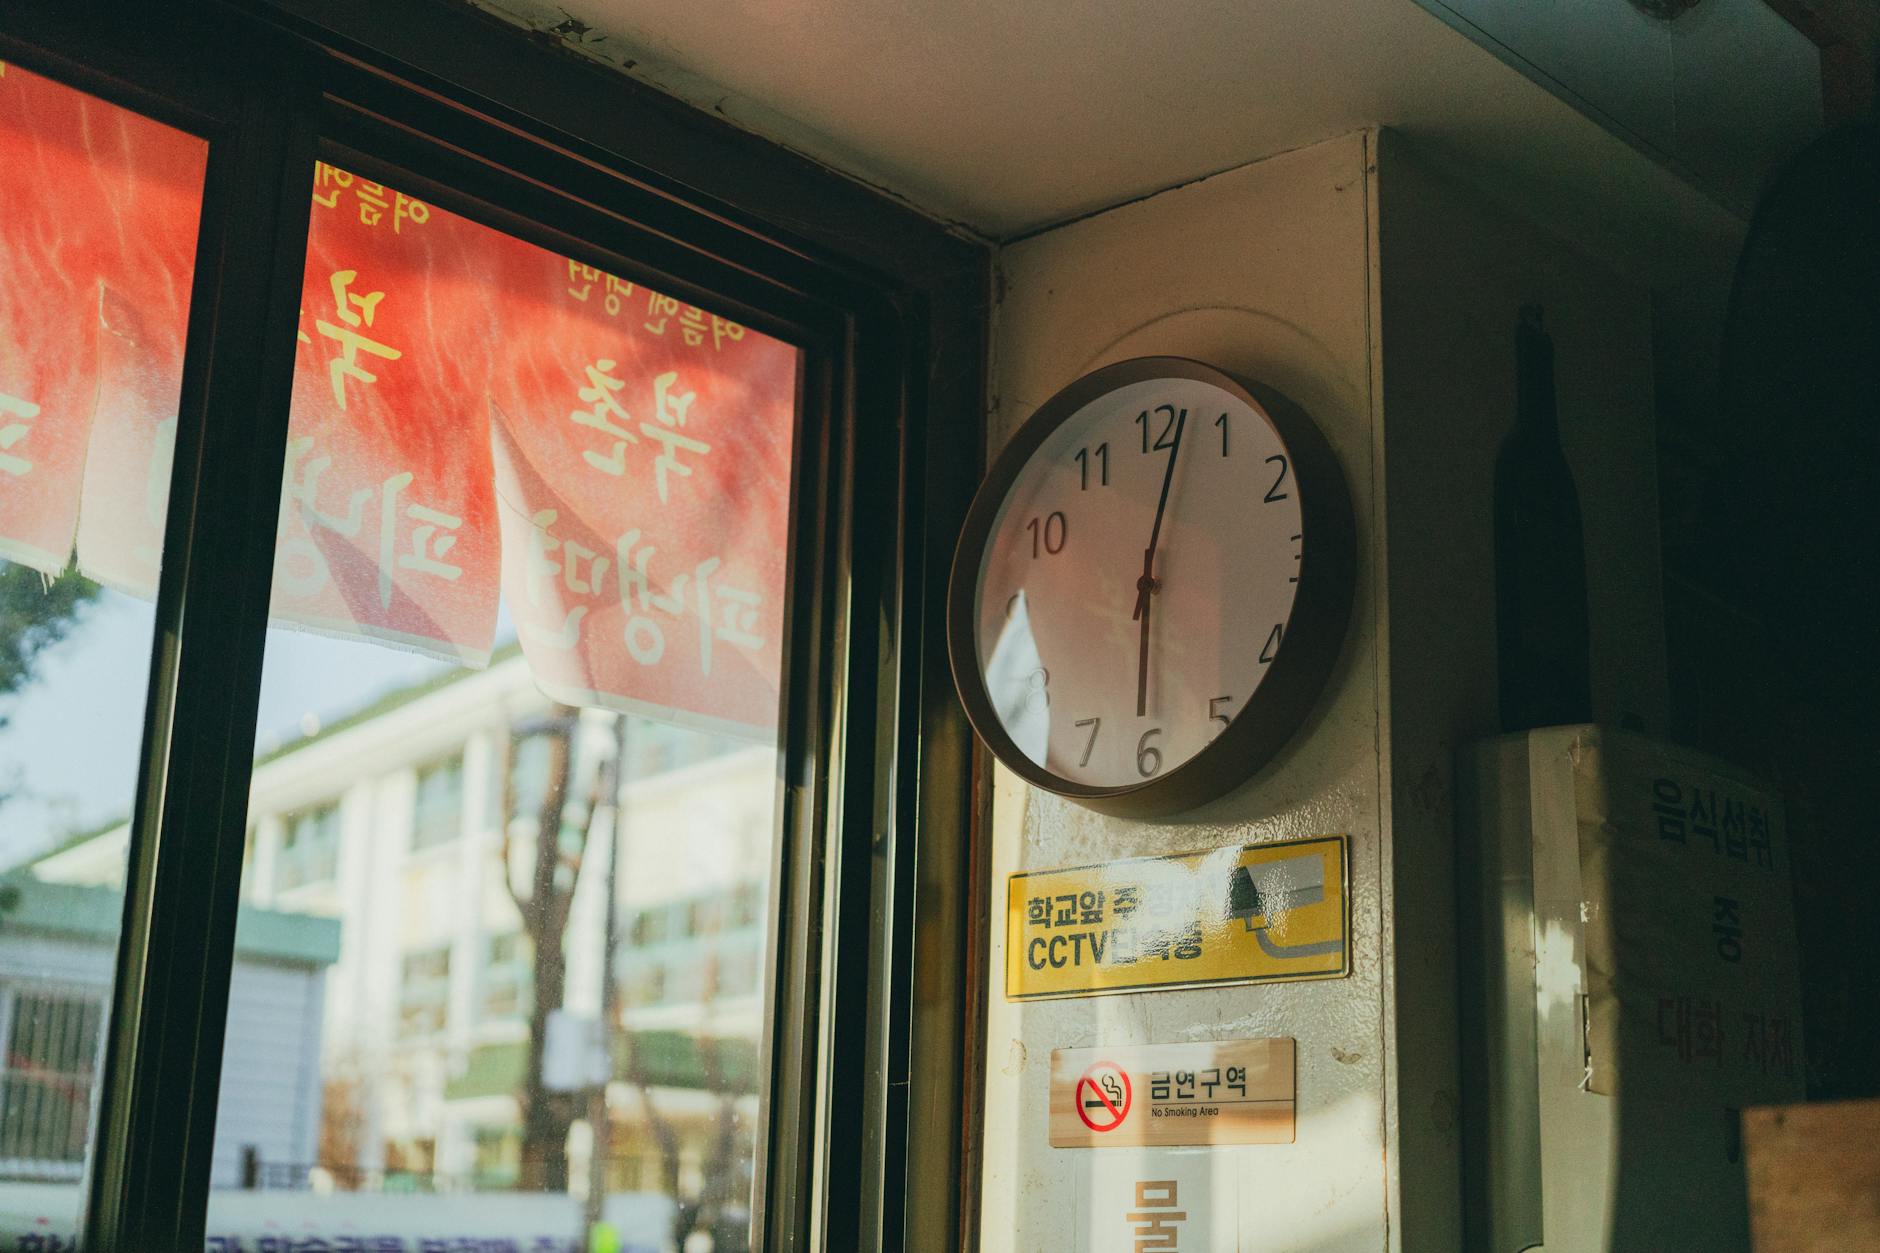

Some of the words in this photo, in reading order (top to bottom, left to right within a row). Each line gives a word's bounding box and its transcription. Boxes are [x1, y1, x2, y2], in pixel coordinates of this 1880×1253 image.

[1135, 404, 1178, 453] 12
[1215, 412, 1229, 457] 1
[1074, 442, 1109, 491] 11
[1264, 454, 1288, 504] 2
[1026, 511, 1067, 559] 10
[1075, 717, 1099, 767] 7
[1137, 728, 1162, 778] 6
[1028, 891, 1105, 929] 학교앞
[1151, 1066, 1246, 1100] 금연구역
[1151, 1107, 1162, 1117] No
[1164, 1106, 1198, 1118] Smoking
[1199, 1106, 1219, 1116] Area
